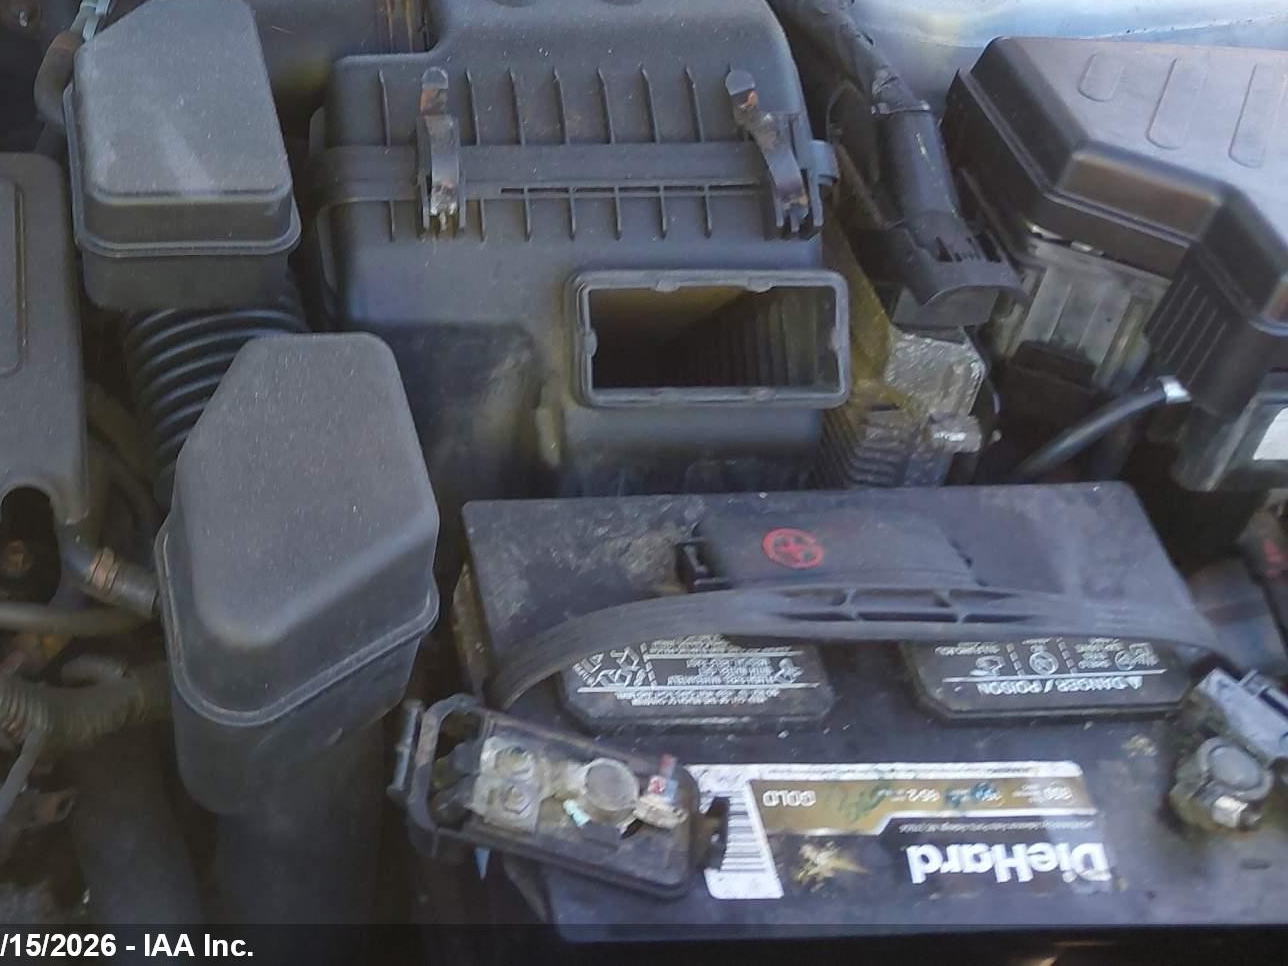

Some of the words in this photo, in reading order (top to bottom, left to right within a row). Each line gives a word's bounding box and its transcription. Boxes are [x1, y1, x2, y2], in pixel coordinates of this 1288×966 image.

[975, 680, 1043, 696] POISON
[1054, 676, 1128, 694] DANGER
[762, 789, 817, 807] GOLD
[905, 842, 1112, 884] DieHard
